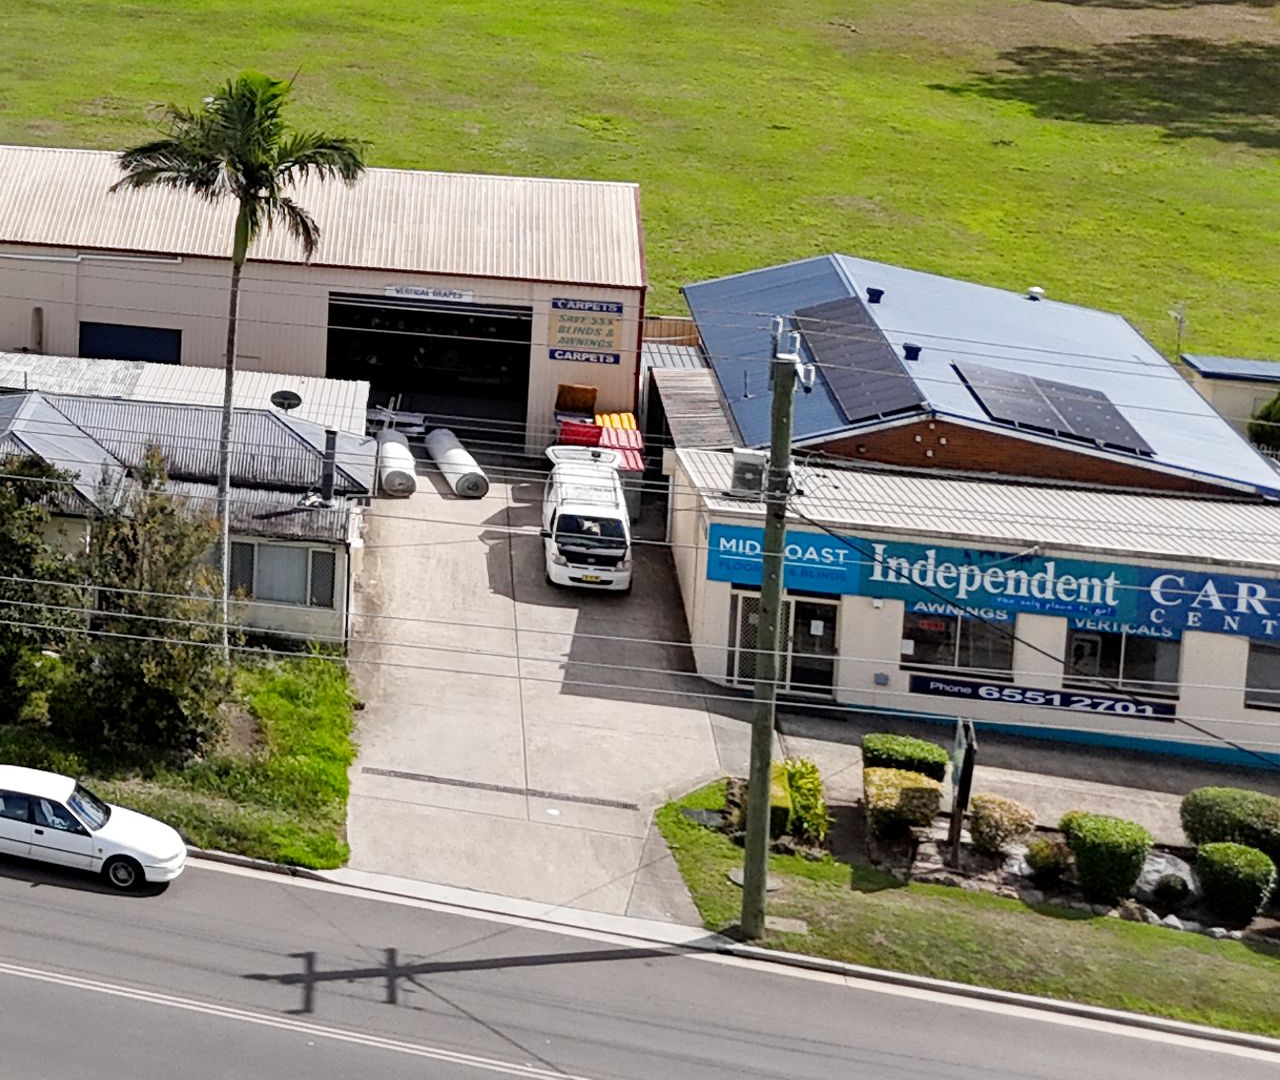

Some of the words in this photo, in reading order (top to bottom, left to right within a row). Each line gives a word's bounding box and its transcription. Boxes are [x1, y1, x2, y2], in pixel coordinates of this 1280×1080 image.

[557, 300, 618, 311] CARPETS
[554, 351, 615, 363] CARPETS
[719, 537, 761, 555] MID
[784, 544, 849, 564] OAST
[800, 570, 848, 582] BLINDS
[869, 543, 1121, 606] Independent
[1150, 574, 1280, 617] CAR
[913, 601, 1009, 620] AWNINGS
[1074, 618, 1174, 638] VERTICALS
[929, 680, 972, 695] Phone
[977, 686, 1062, 706] 6551
[1069, 696, 1154, 716] 2701
